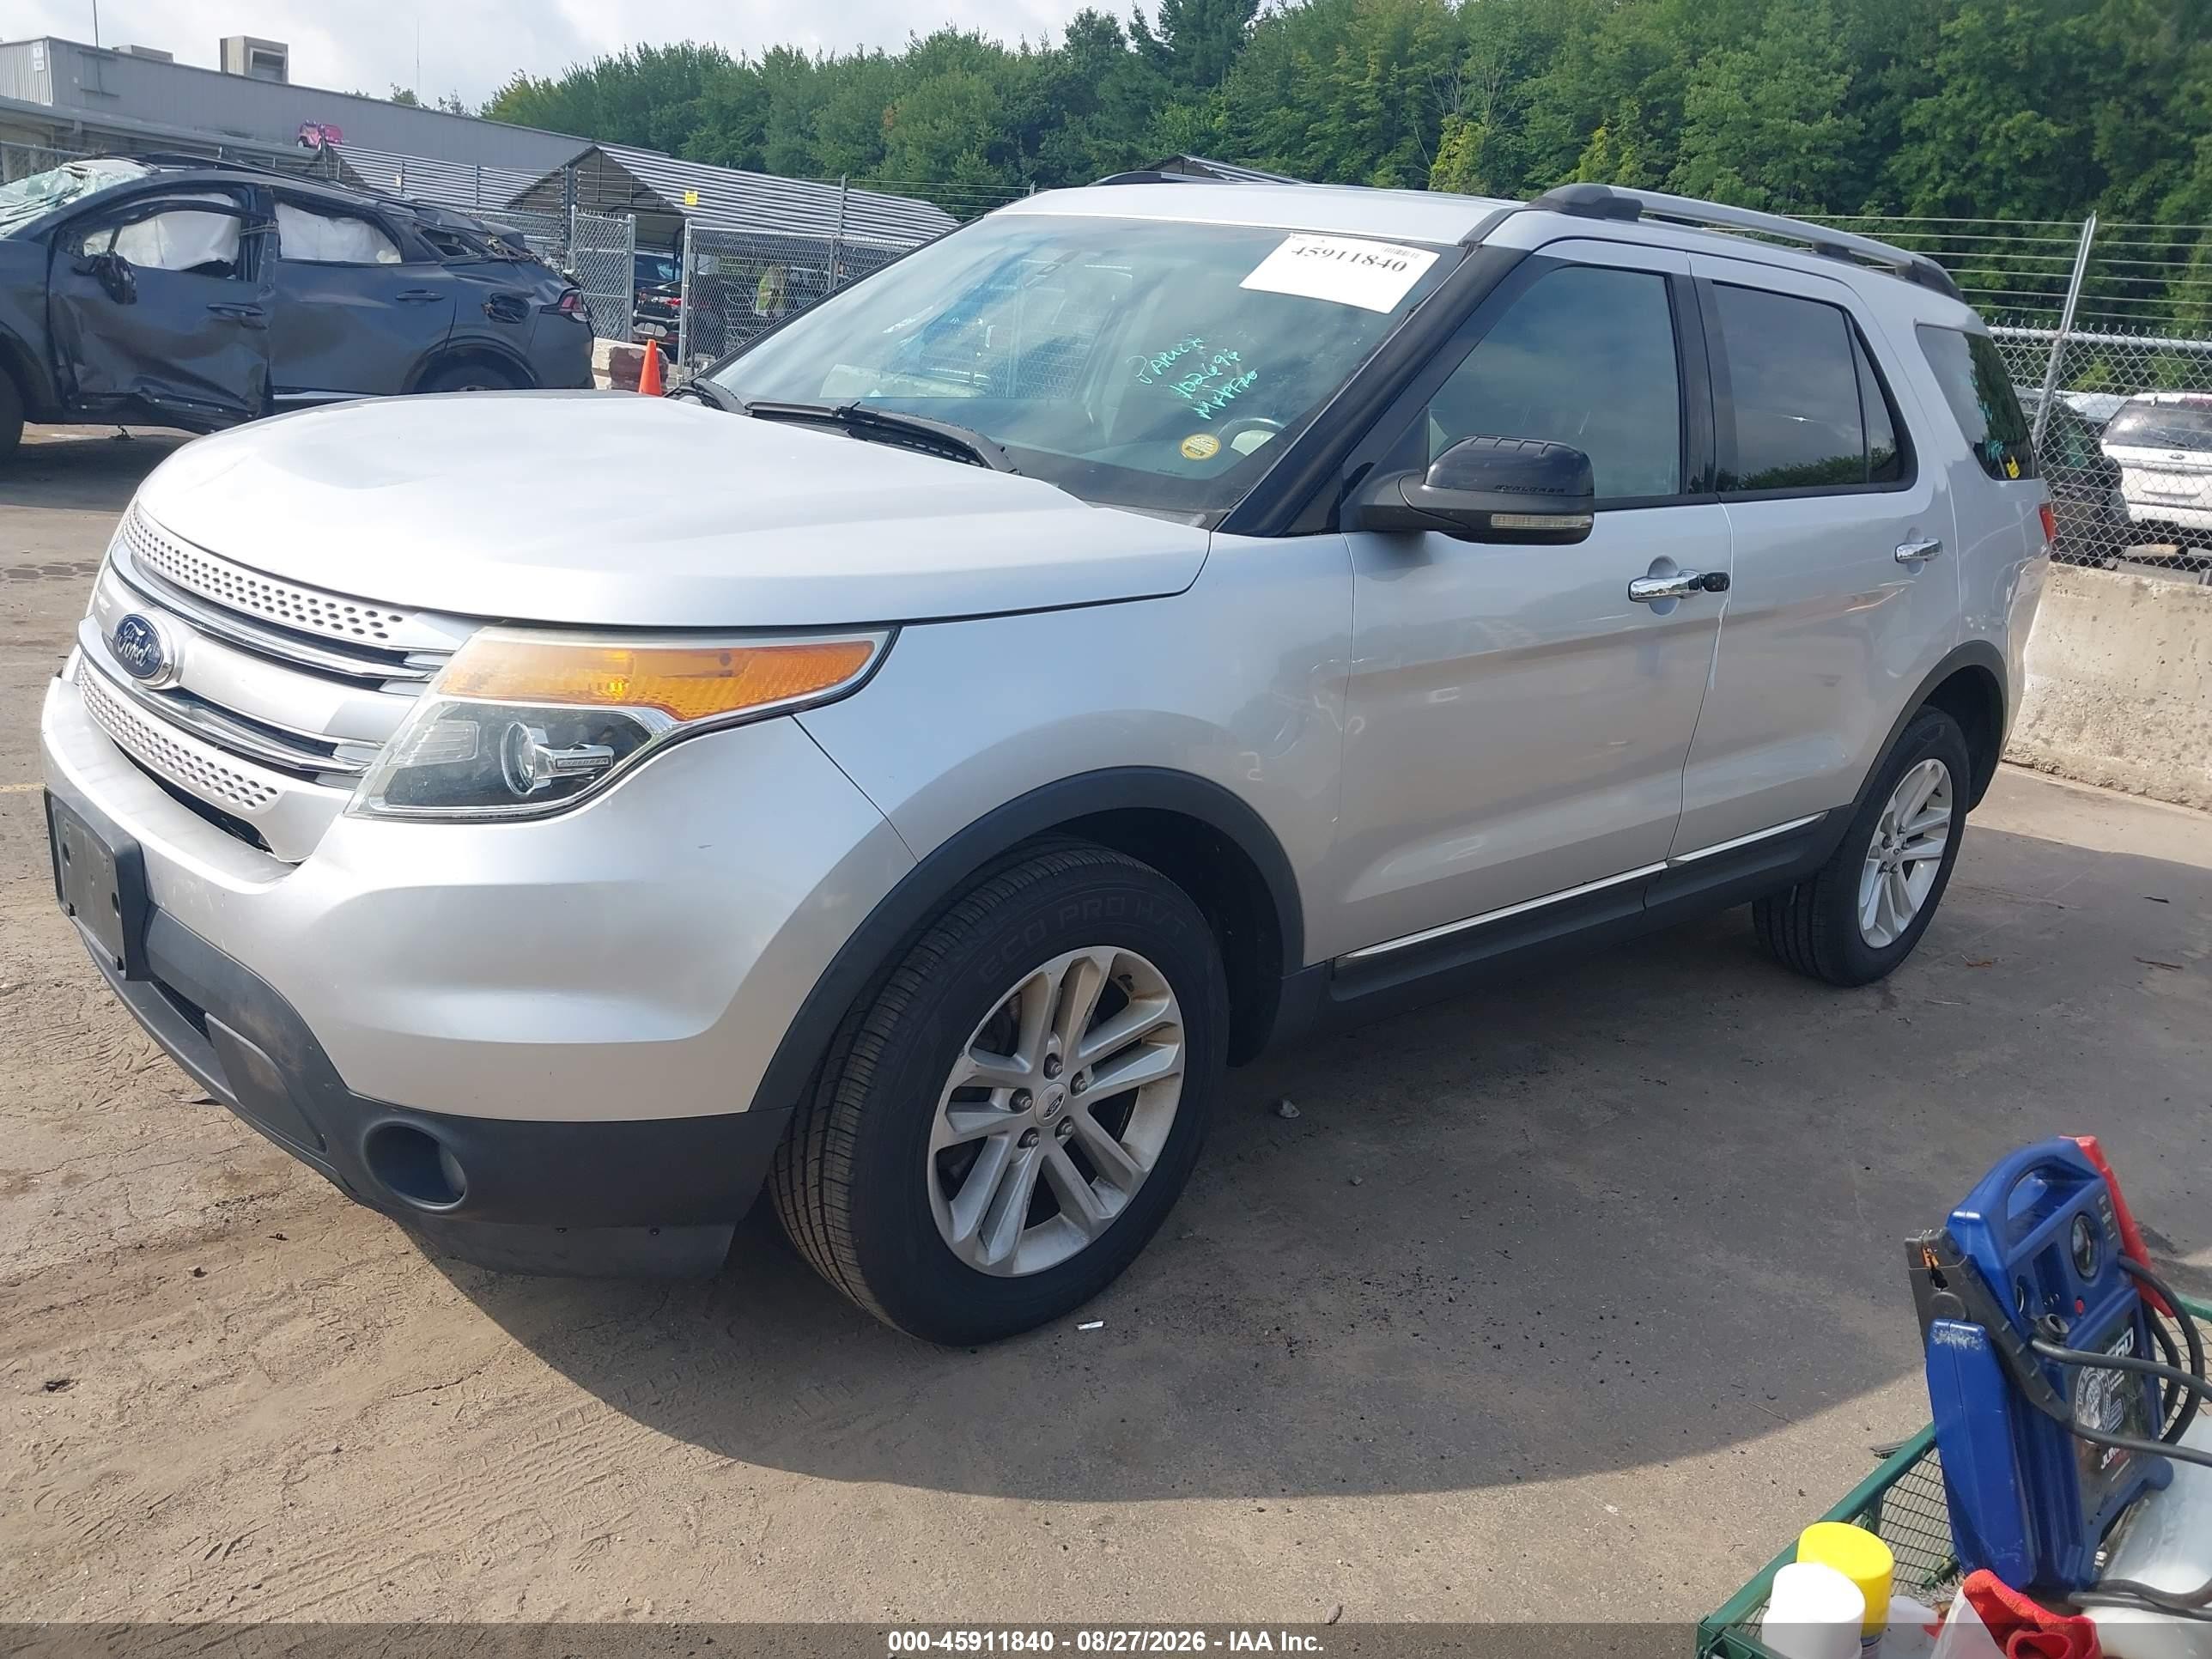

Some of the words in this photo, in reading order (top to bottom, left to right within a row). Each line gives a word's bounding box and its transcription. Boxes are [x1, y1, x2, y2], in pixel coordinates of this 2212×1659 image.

[1291, 246, 1408, 273] 45911840
[118, 621, 153, 667] Ford
[977, 917, 1048, 983] ECO
[1057, 896, 1126, 929] PRO
